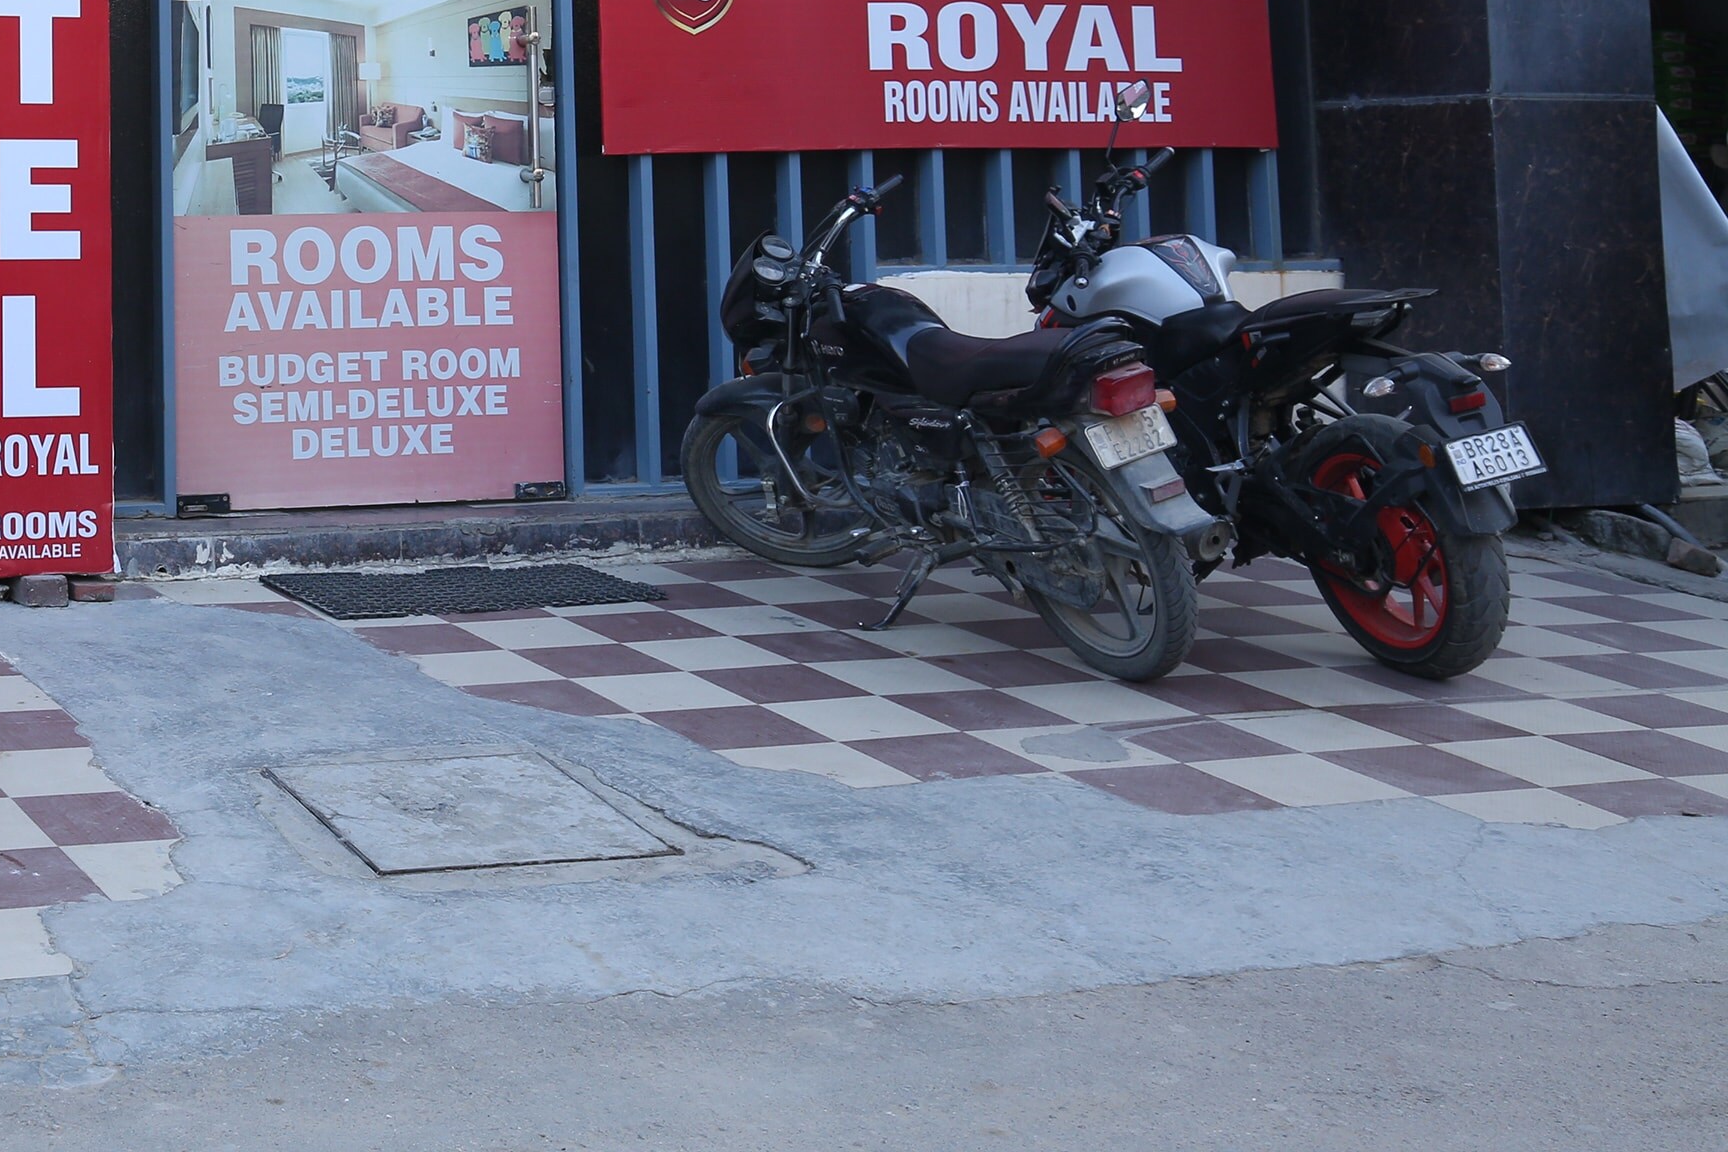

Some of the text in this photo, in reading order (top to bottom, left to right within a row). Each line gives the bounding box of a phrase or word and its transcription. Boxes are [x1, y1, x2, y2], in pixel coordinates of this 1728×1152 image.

[868, 2, 1182, 72] ROYAL
[884, 81, 1171, 122] ROOMS AVAILAE
[230, 225, 504, 285] ROOMS
[224, 287, 513, 332] AVAILABLE
[219, 348, 520, 387] BUDGET ROOM
[233, 385, 508, 425] SEMI-DELUXE
[292, 424, 453, 459] DELUXE
[1103, 410, 1154, 441] P5
[1113, 429, 1165, 461] E2282
[1463, 430, 1522, 458] BR28A
[1473, 449, 1529, 479] A6013
